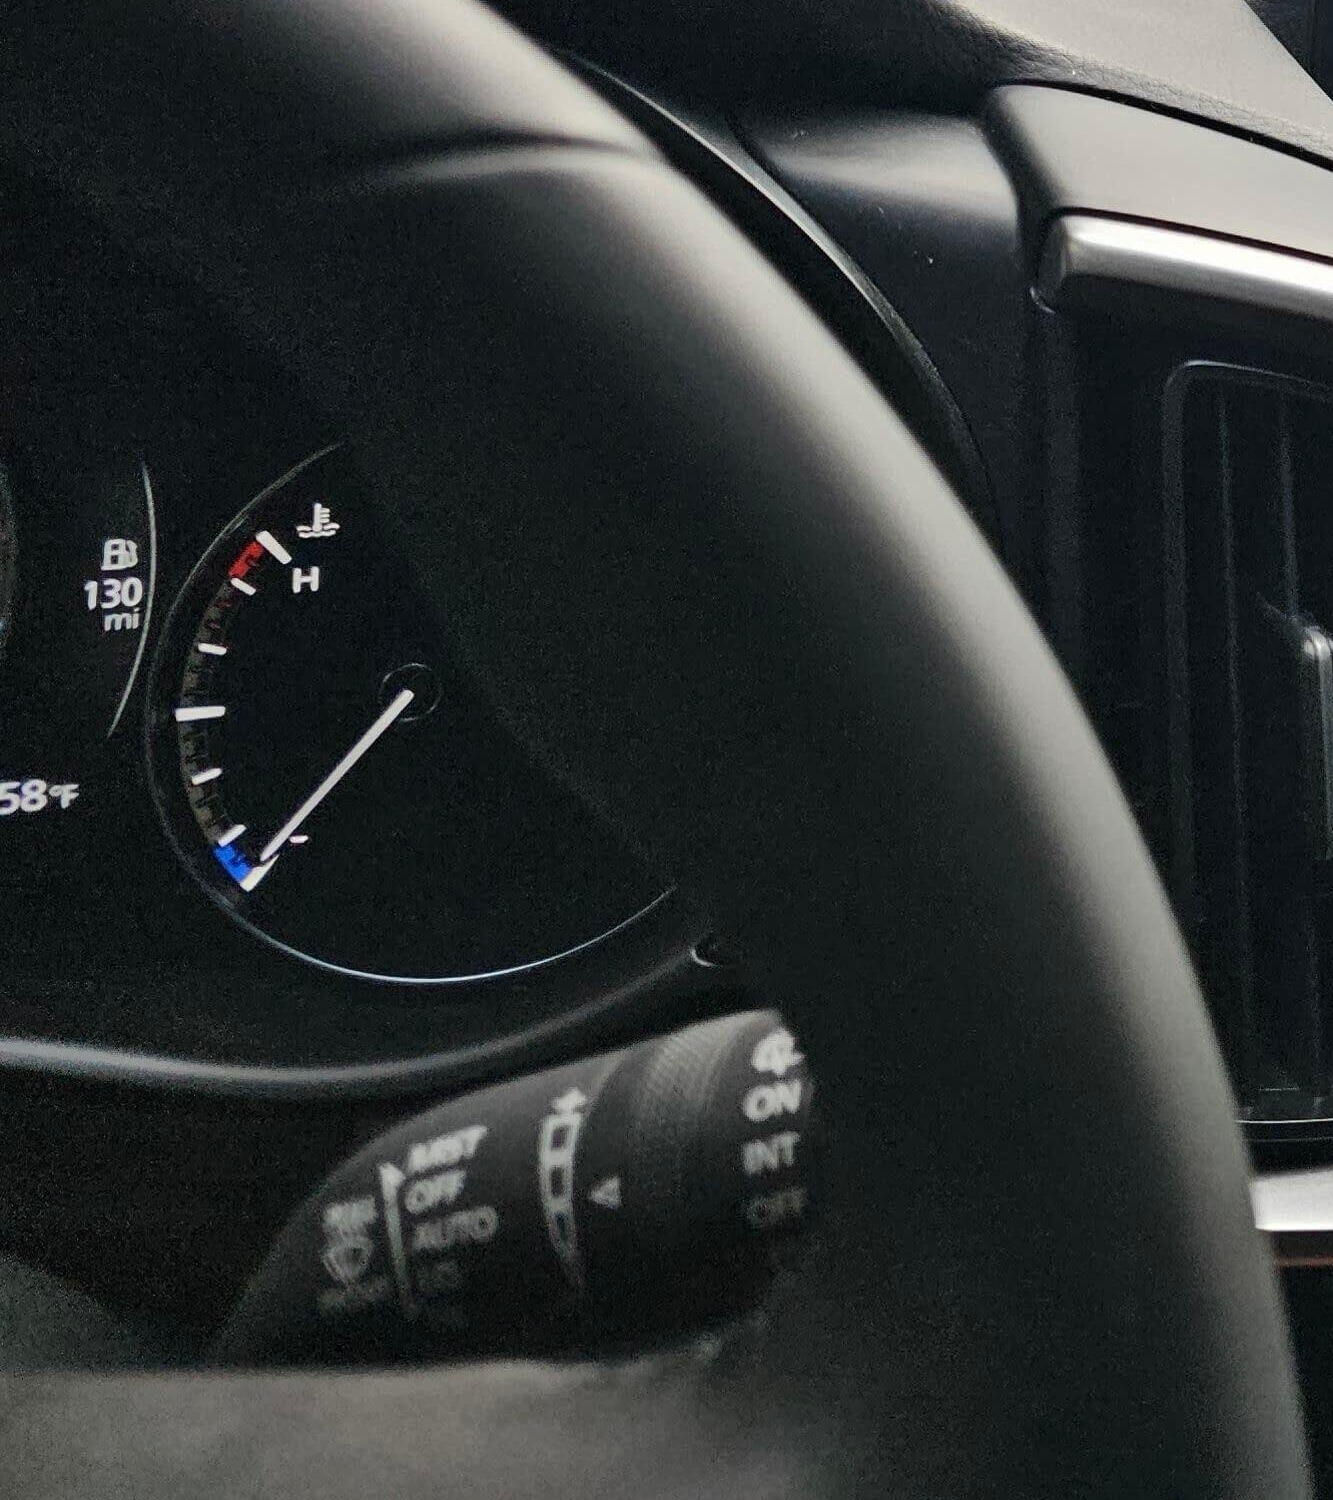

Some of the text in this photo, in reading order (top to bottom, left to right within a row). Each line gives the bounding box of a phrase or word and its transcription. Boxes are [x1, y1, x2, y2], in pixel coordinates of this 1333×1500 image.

[83, 576, 144, 611] 130
[291, 566, 320, 594] H
[103, 607, 140, 632] mi
[743, 1079, 802, 1122] ON
[404, 1169, 467, 1216] OFF
